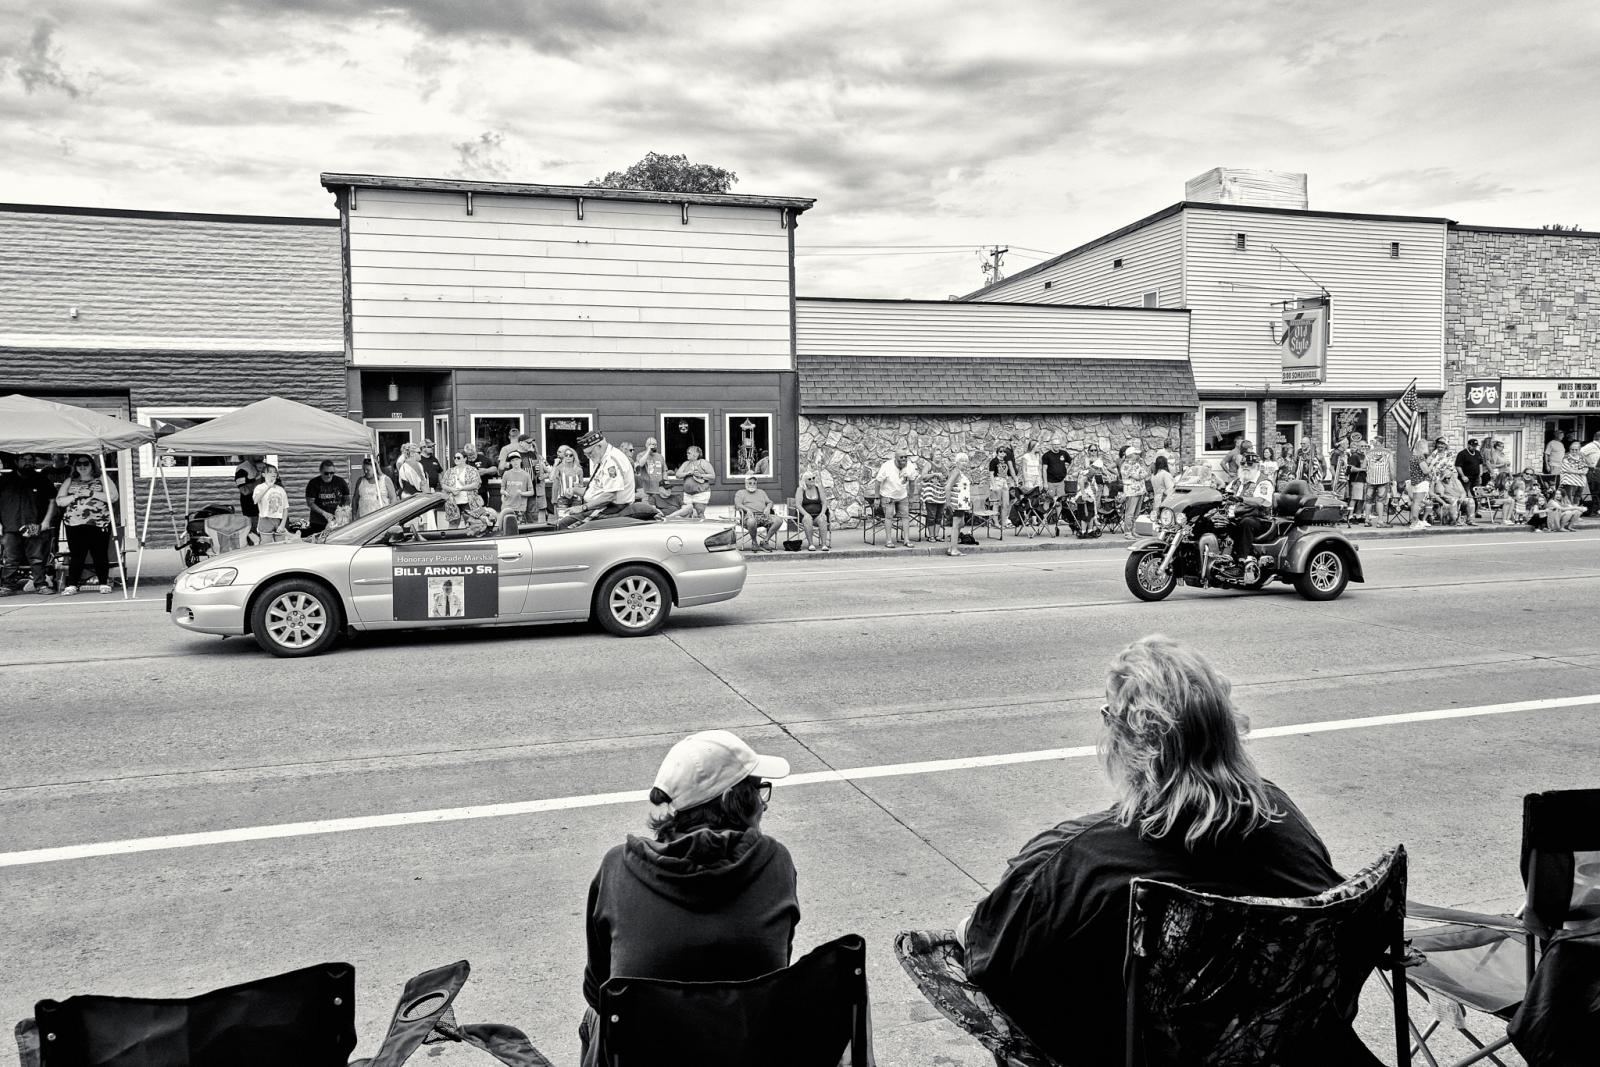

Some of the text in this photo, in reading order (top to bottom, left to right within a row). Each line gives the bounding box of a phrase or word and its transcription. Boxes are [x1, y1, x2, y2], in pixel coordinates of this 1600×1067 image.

[1294, 325, 1308, 338] Old
[1291, 335, 1309, 352] Style
[397, 555, 434, 563] Honorary
[394, 565, 496, 576] BILL ARNOLD SR.
